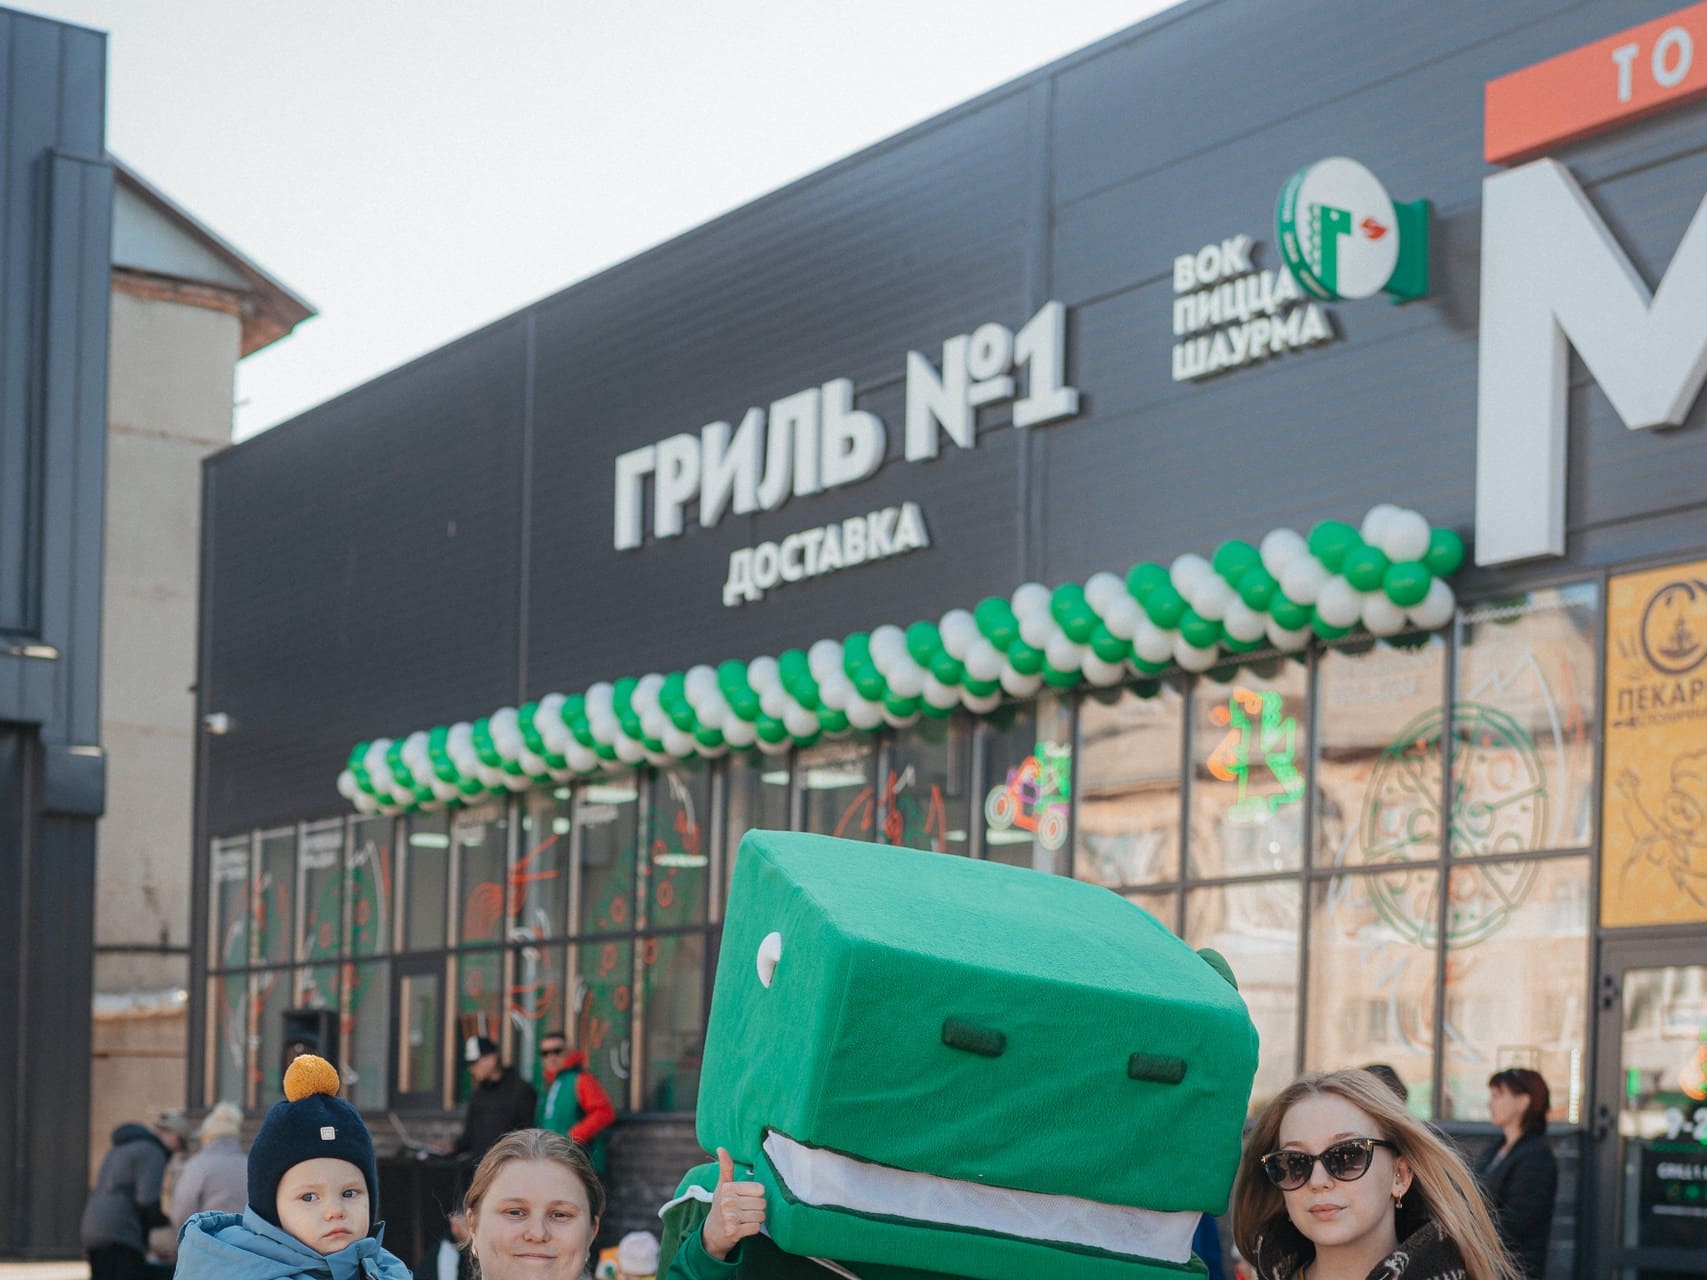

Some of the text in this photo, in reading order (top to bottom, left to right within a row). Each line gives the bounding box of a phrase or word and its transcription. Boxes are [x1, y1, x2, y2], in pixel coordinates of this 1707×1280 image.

[1173, 234, 1250, 293] ВОК
[1173, 264, 1299, 336] ПИЦЦА
[1172, 303, 1332, 381] ШАУРМА
[614, 300, 1079, 551] ГРИЛЬ №1
[723, 502, 931, 606] ДОСТАВКА
